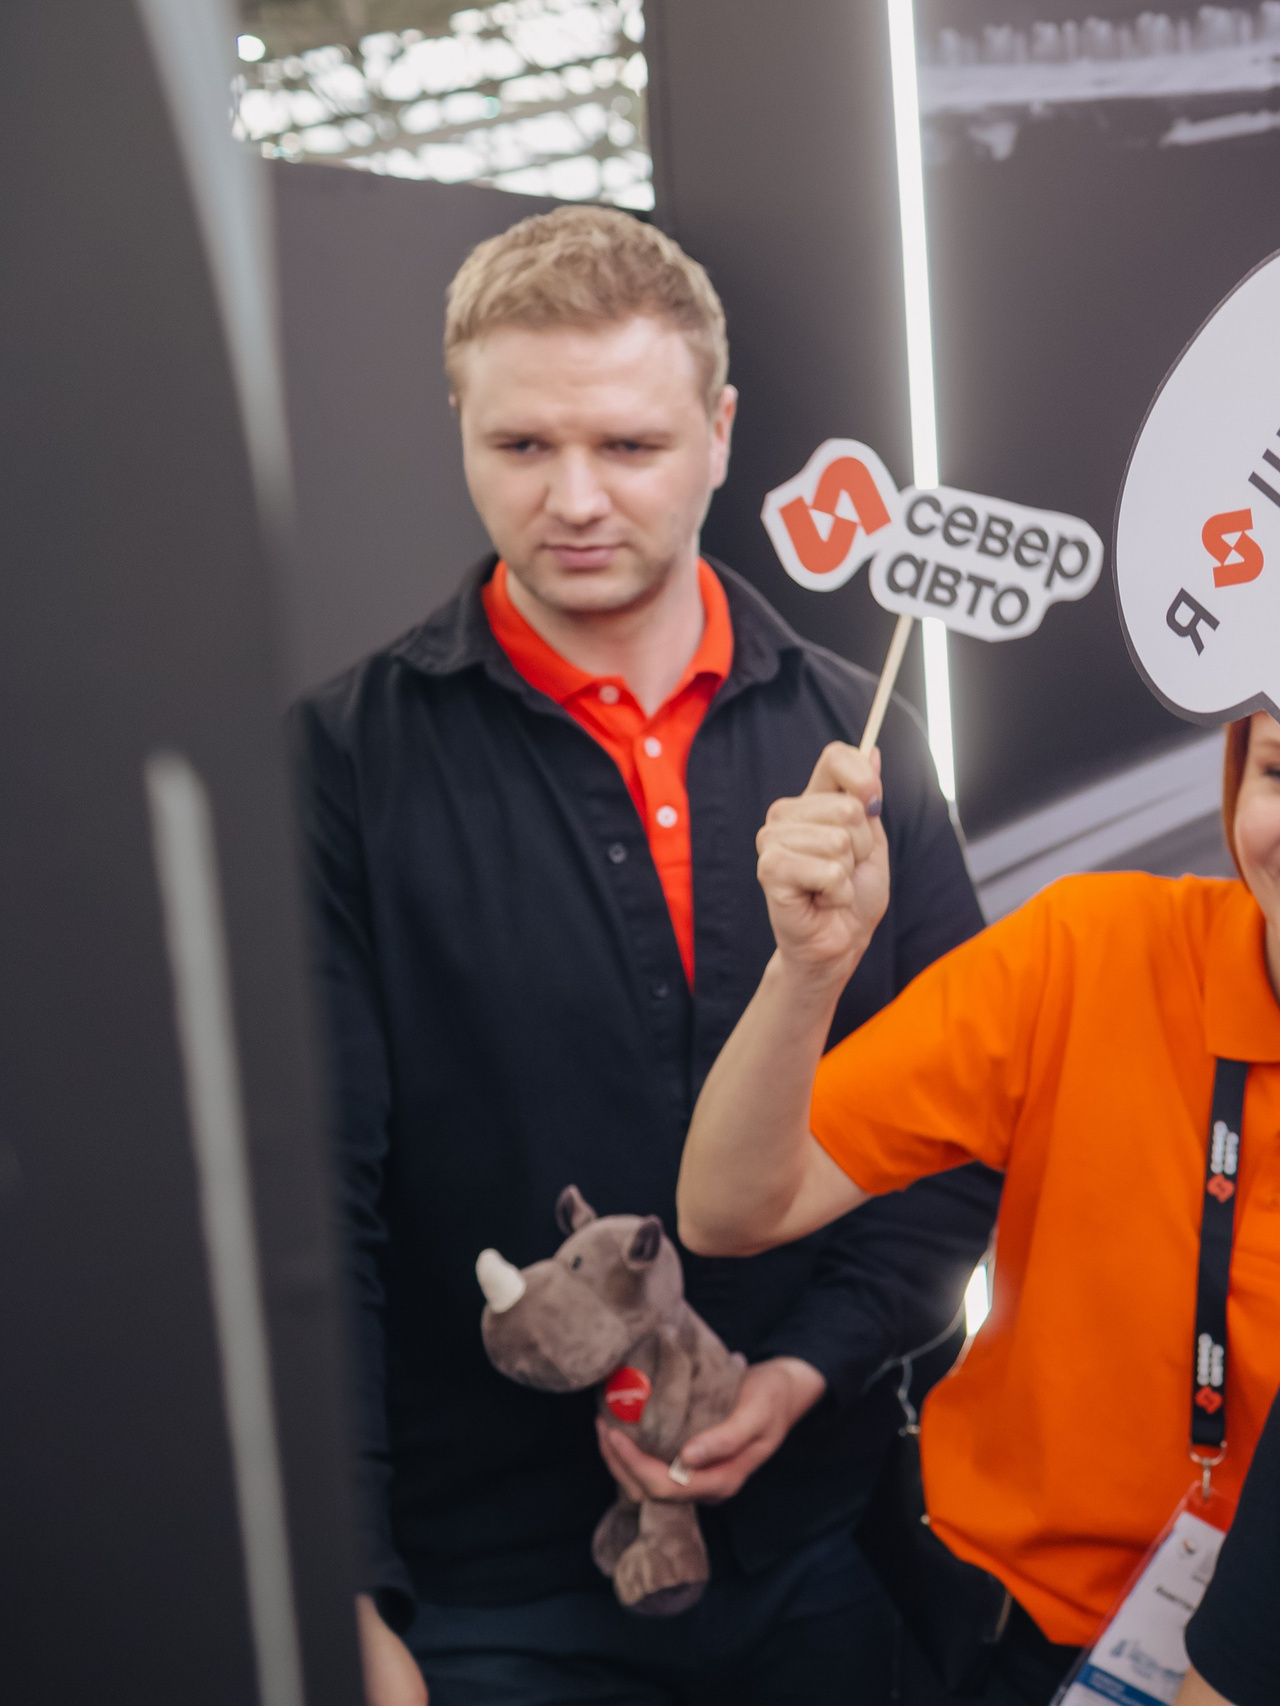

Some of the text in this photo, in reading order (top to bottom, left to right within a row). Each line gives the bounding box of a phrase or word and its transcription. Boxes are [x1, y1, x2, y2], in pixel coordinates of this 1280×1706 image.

[904, 494, 1090, 591] север
[886, 552, 1030, 627] авто
[1165, 586, 1221, 657] Я
